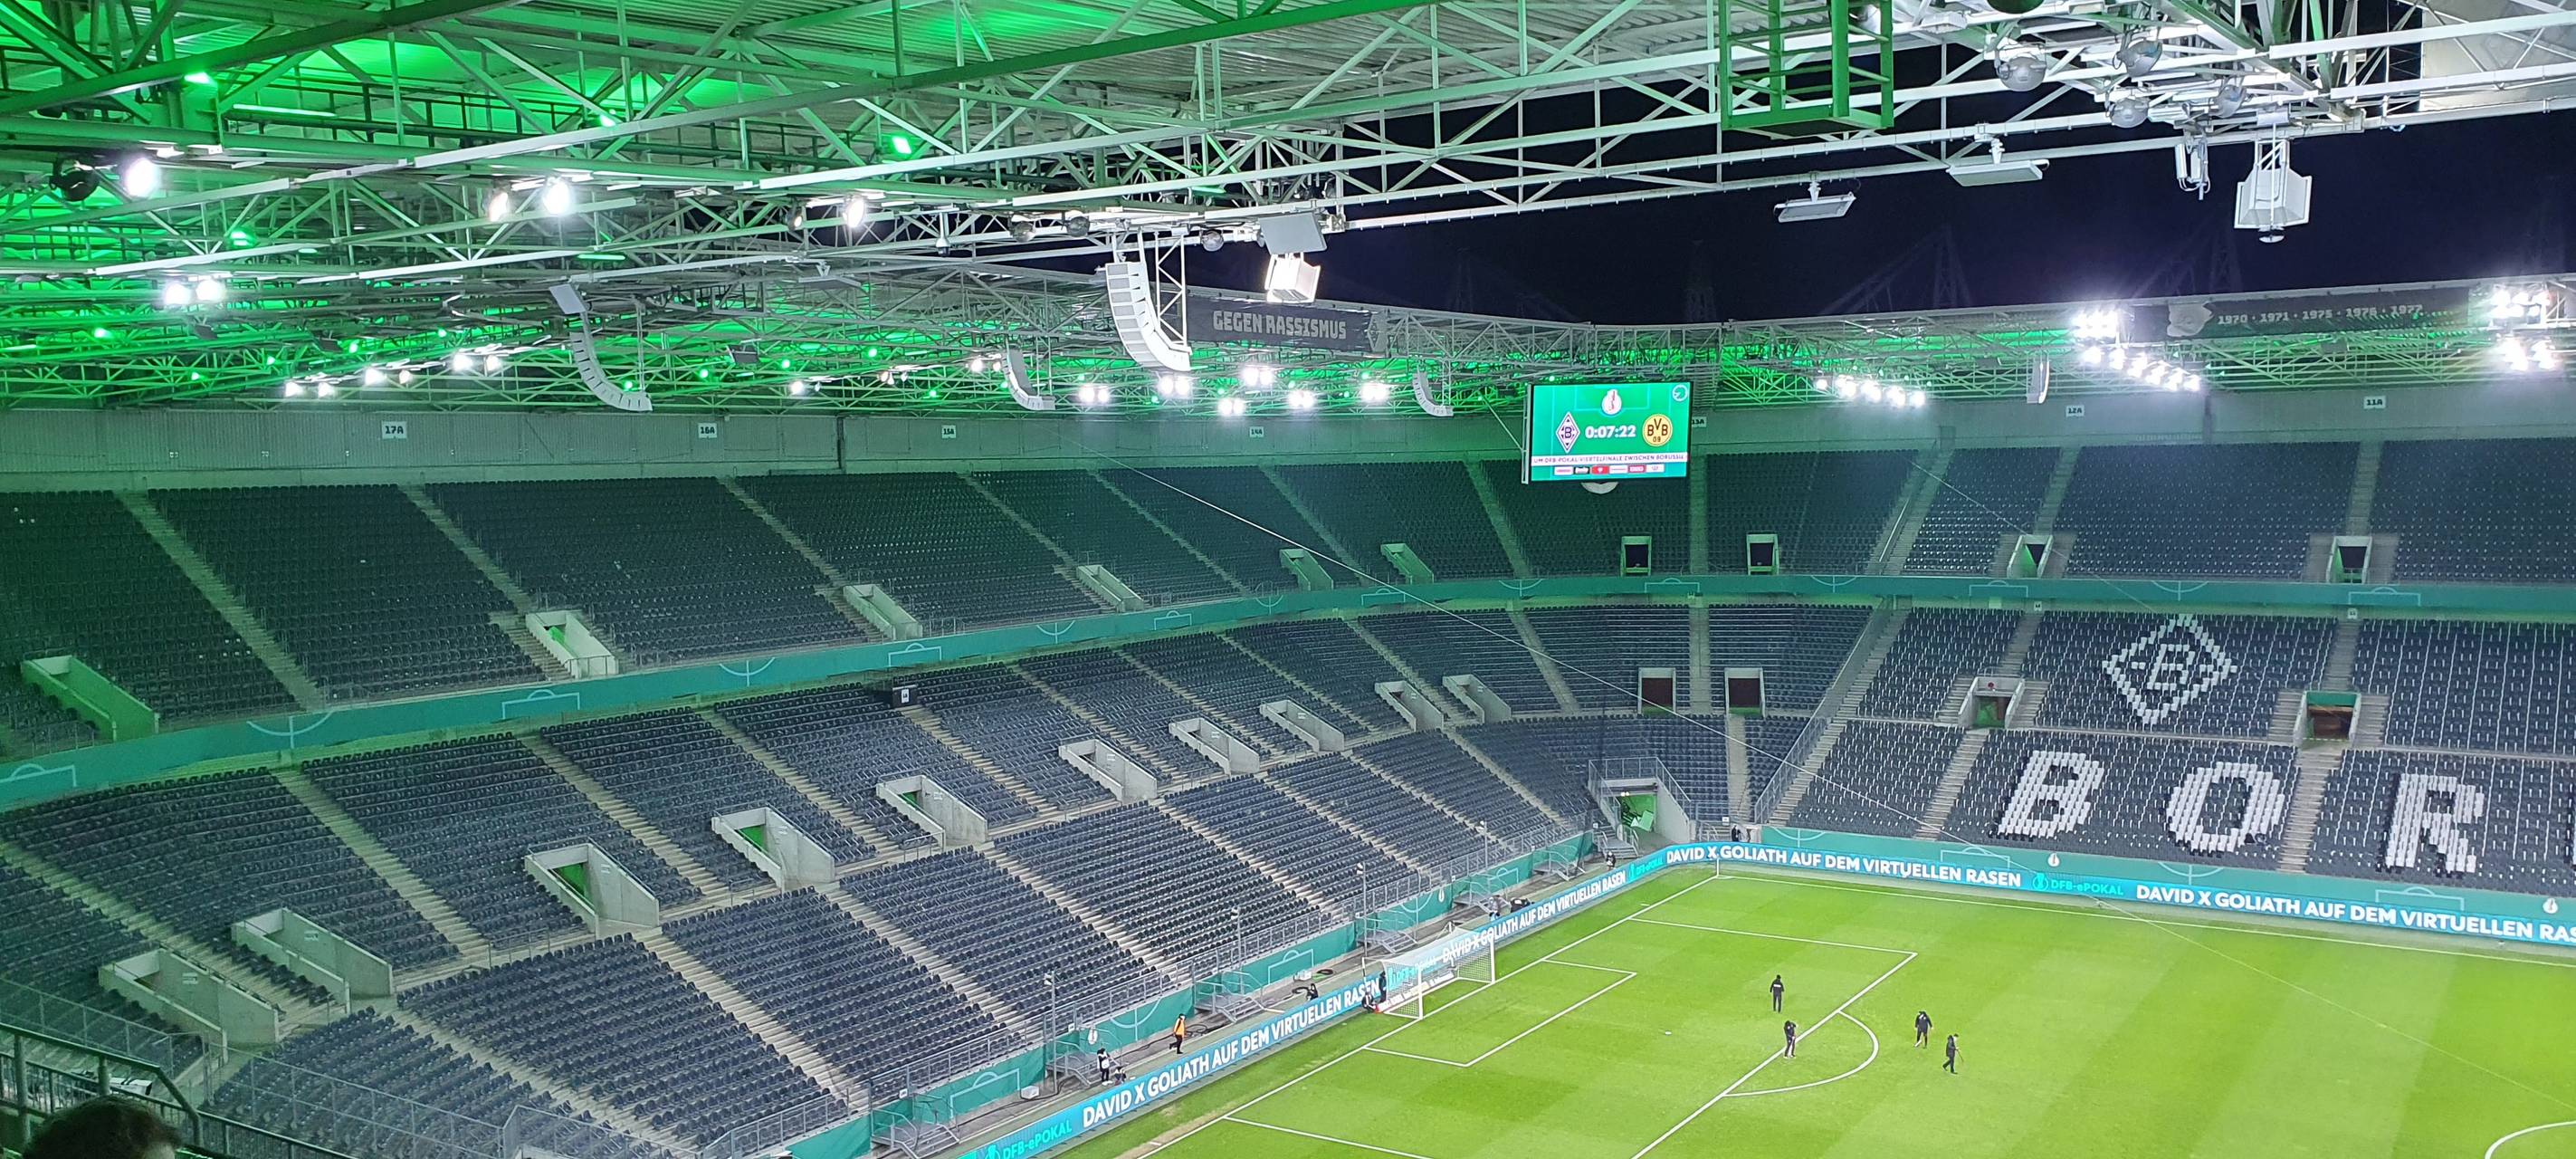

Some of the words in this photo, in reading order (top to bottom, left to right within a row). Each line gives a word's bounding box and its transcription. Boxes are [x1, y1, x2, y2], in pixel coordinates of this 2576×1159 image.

[1213, 311, 1263, 332] GEGEN
[1266, 315, 1347, 340] RASSISMUS
[2218, 314, 2247, 325] 1970
[2259, 311, 2289, 322] 1971
[2302, 309, 2333, 320] 1975
[2390, 304, 2423, 315] 1977
[385, 426, 404, 435] 17A
[1585, 426, 1636, 438] 0:07:22
[1647, 418, 1668, 436] BVB
[1666, 847, 1704, 864] DAVID
[1707, 846, 1718, 858] X
[1720, 846, 1787, 864] GOLIATH
[1790, 851, 1822, 867] AUF
[1825, 856, 1859, 871] DEM
[1863, 859, 1961, 882] VIRTUELLEN
[1966, 868, 2020, 887] RASEN
[1519, 911, 1536, 928] AUF
[1537, 902, 1556, 921] DEM
[1556, 884, 1602, 911] VIRTUELLEN
[1602, 870, 1626, 892] RASEN
[2050, 879, 2124, 896] DFB-ePOKAL
[2136, 885, 2194, 904] DAVID
[2198, 891, 2212, 905] X
[2215, 893, 2300, 915] GOLIATH
[2304, 901, 2346, 919] AUF
[2350, 905, 2397, 924] DEM
[2399, 909, 2533, 939] VIRTUELLEN
[1083, 1089, 1131, 1127] DAVID
[1135, 1081, 1145, 1105] X
[1148, 1053, 1209, 1097] GOLIATH
[1212, 1041, 1238, 1068] AUF
[1241, 1025, 1269, 1055] DEM
[1272, 994, 1342, 1039] VIRTUELLEN
[1344, 977, 1380, 1008] RASEN
[1003, 1120, 1073, 1159] DFB-ePOKAL
